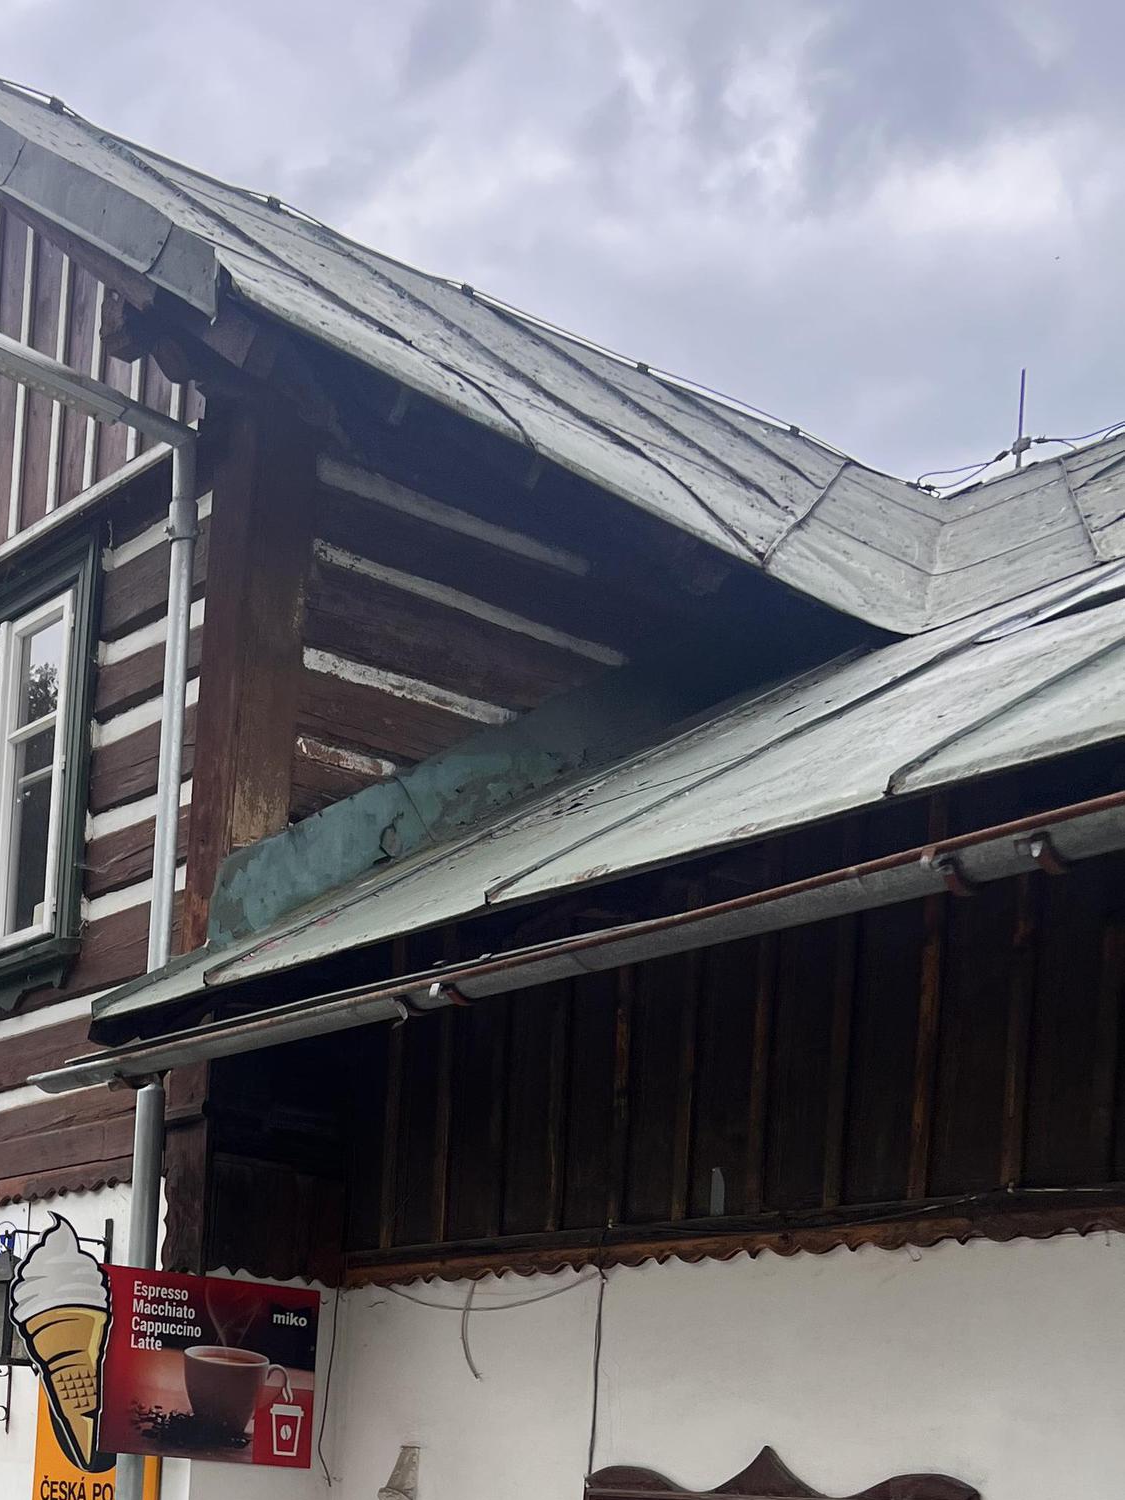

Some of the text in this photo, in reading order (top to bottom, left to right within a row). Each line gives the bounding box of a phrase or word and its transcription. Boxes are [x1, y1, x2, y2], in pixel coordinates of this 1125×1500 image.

[133, 1280, 189, 1301] Espresso
[132, 1299, 196, 1320] Macchiato
[273, 1312, 308, 1327] miko
[131, 1316, 202, 1338] Cappuccino
[130, 1334, 163, 1351] Latte
